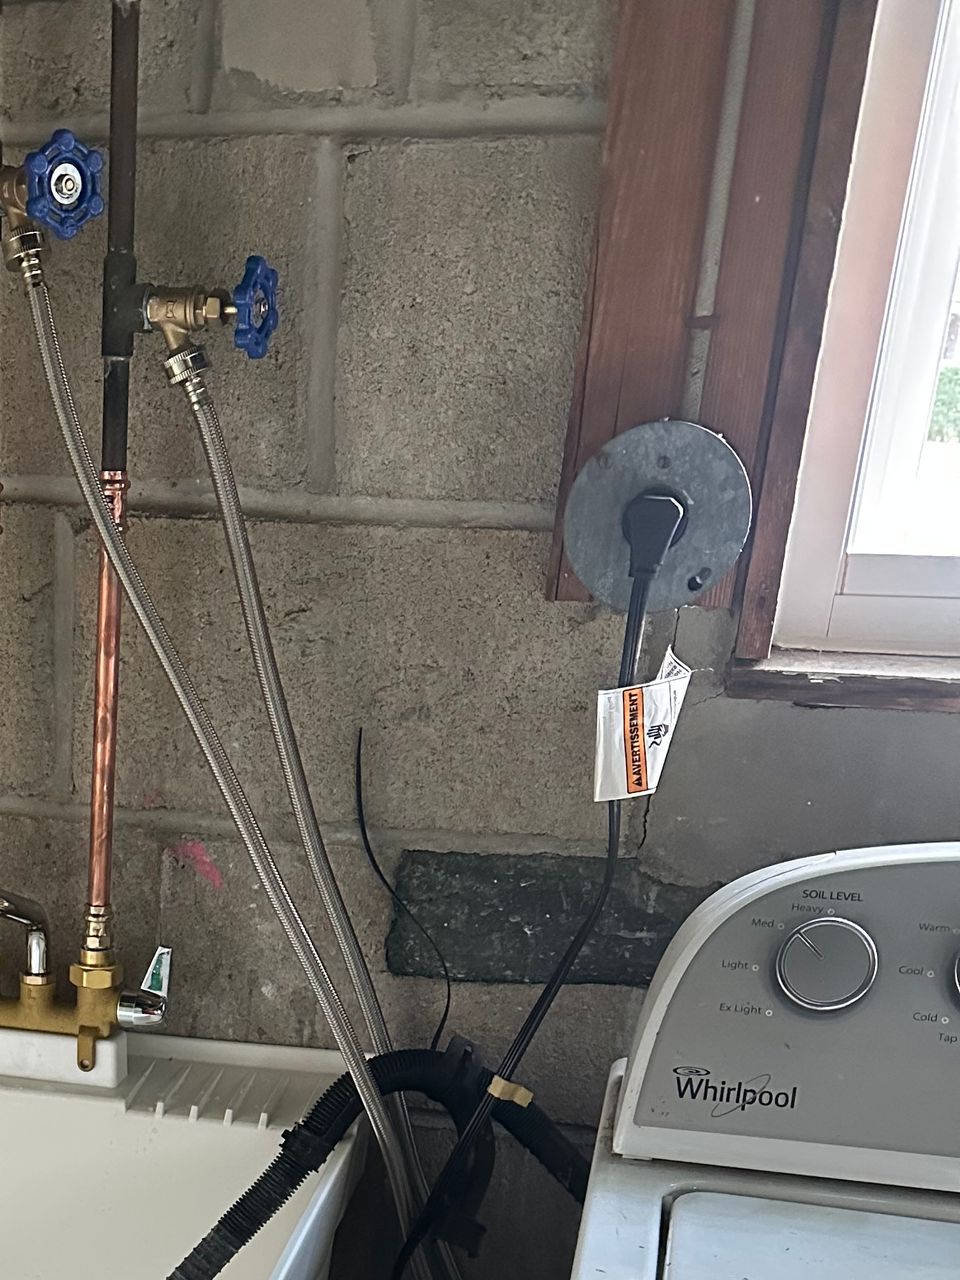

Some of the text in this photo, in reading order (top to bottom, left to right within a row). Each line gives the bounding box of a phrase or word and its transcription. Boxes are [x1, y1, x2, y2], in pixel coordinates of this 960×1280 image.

[629, 693, 642, 775] AVERTISSEMENT
[802, 889, 864, 902] SOIL LEVEL
[792, 903, 824, 914] Heavy
[751, 918, 774, 928] Med
[919, 923, 950, 933] Warm
[722, 960, 748, 971] Light
[898, 966, 924, 976] Cool
[720, 1003, 762, 1016] Ex Light
[913, 1012, 938, 1023] Cold
[939, 1033, 958, 1044] Tap
[676, 1076, 798, 1111] Whirlpool
